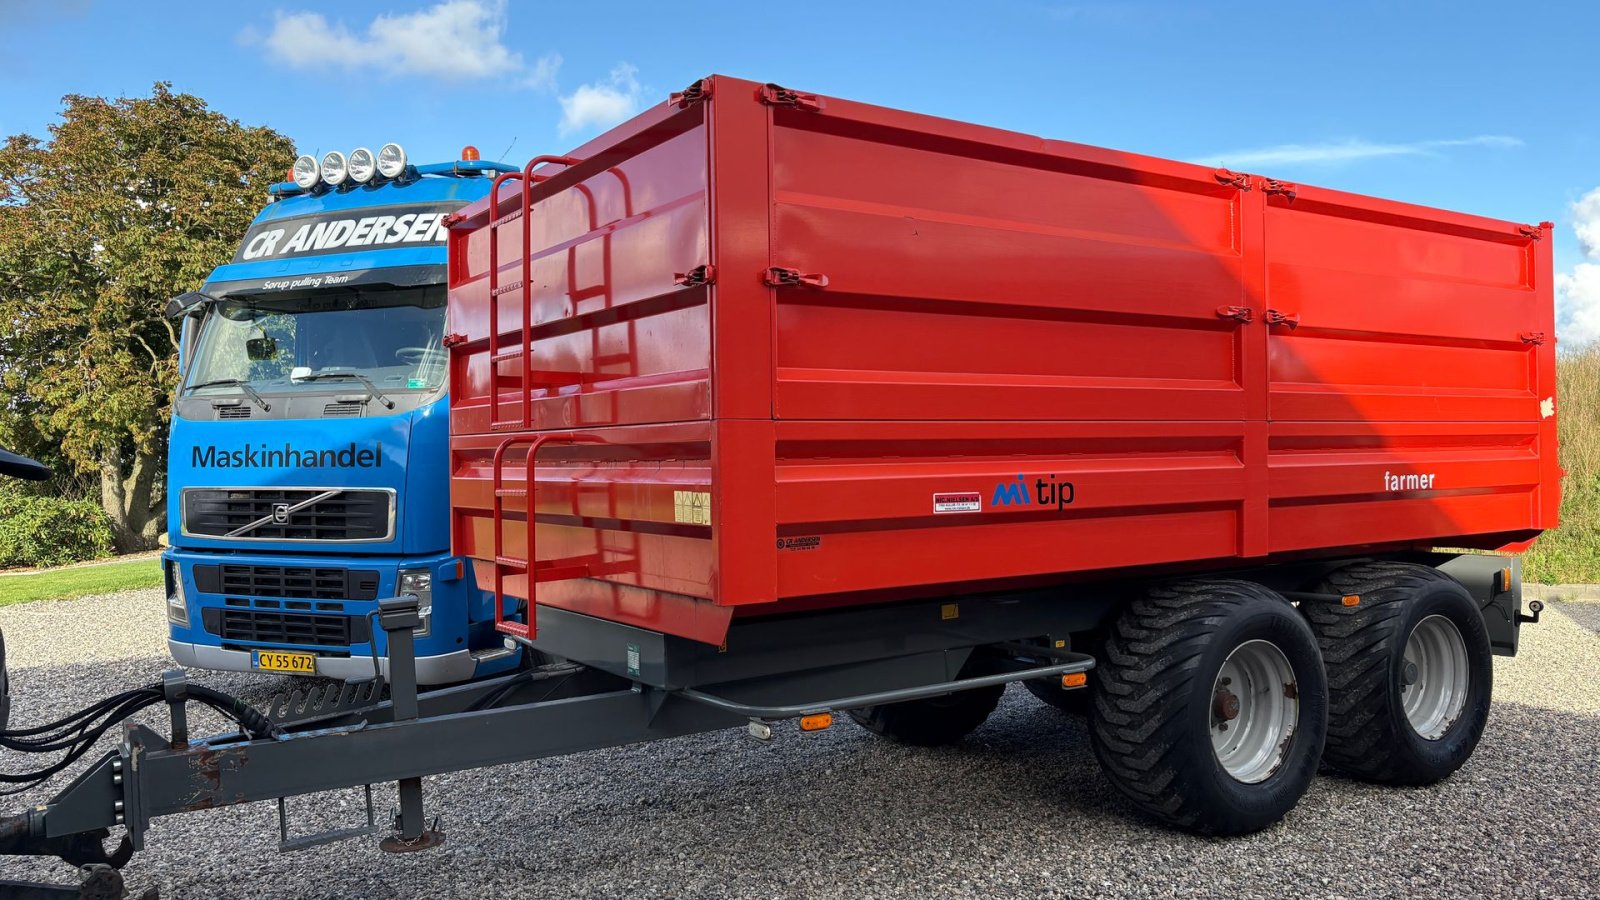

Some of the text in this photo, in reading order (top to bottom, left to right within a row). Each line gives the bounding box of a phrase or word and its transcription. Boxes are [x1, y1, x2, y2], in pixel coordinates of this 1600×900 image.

[242, 229, 285, 261] CR
[290, 276, 322, 290] pulling
[324, 275, 348, 284] Team
[191, 442, 382, 469] Maskinhandel
[1036, 473, 1074, 512] tip
[1384, 471, 1435, 491] farmer
[260, 654, 273, 667] CY
[276, 656, 289, 668] 55
[292, 656, 312, 669] 672
